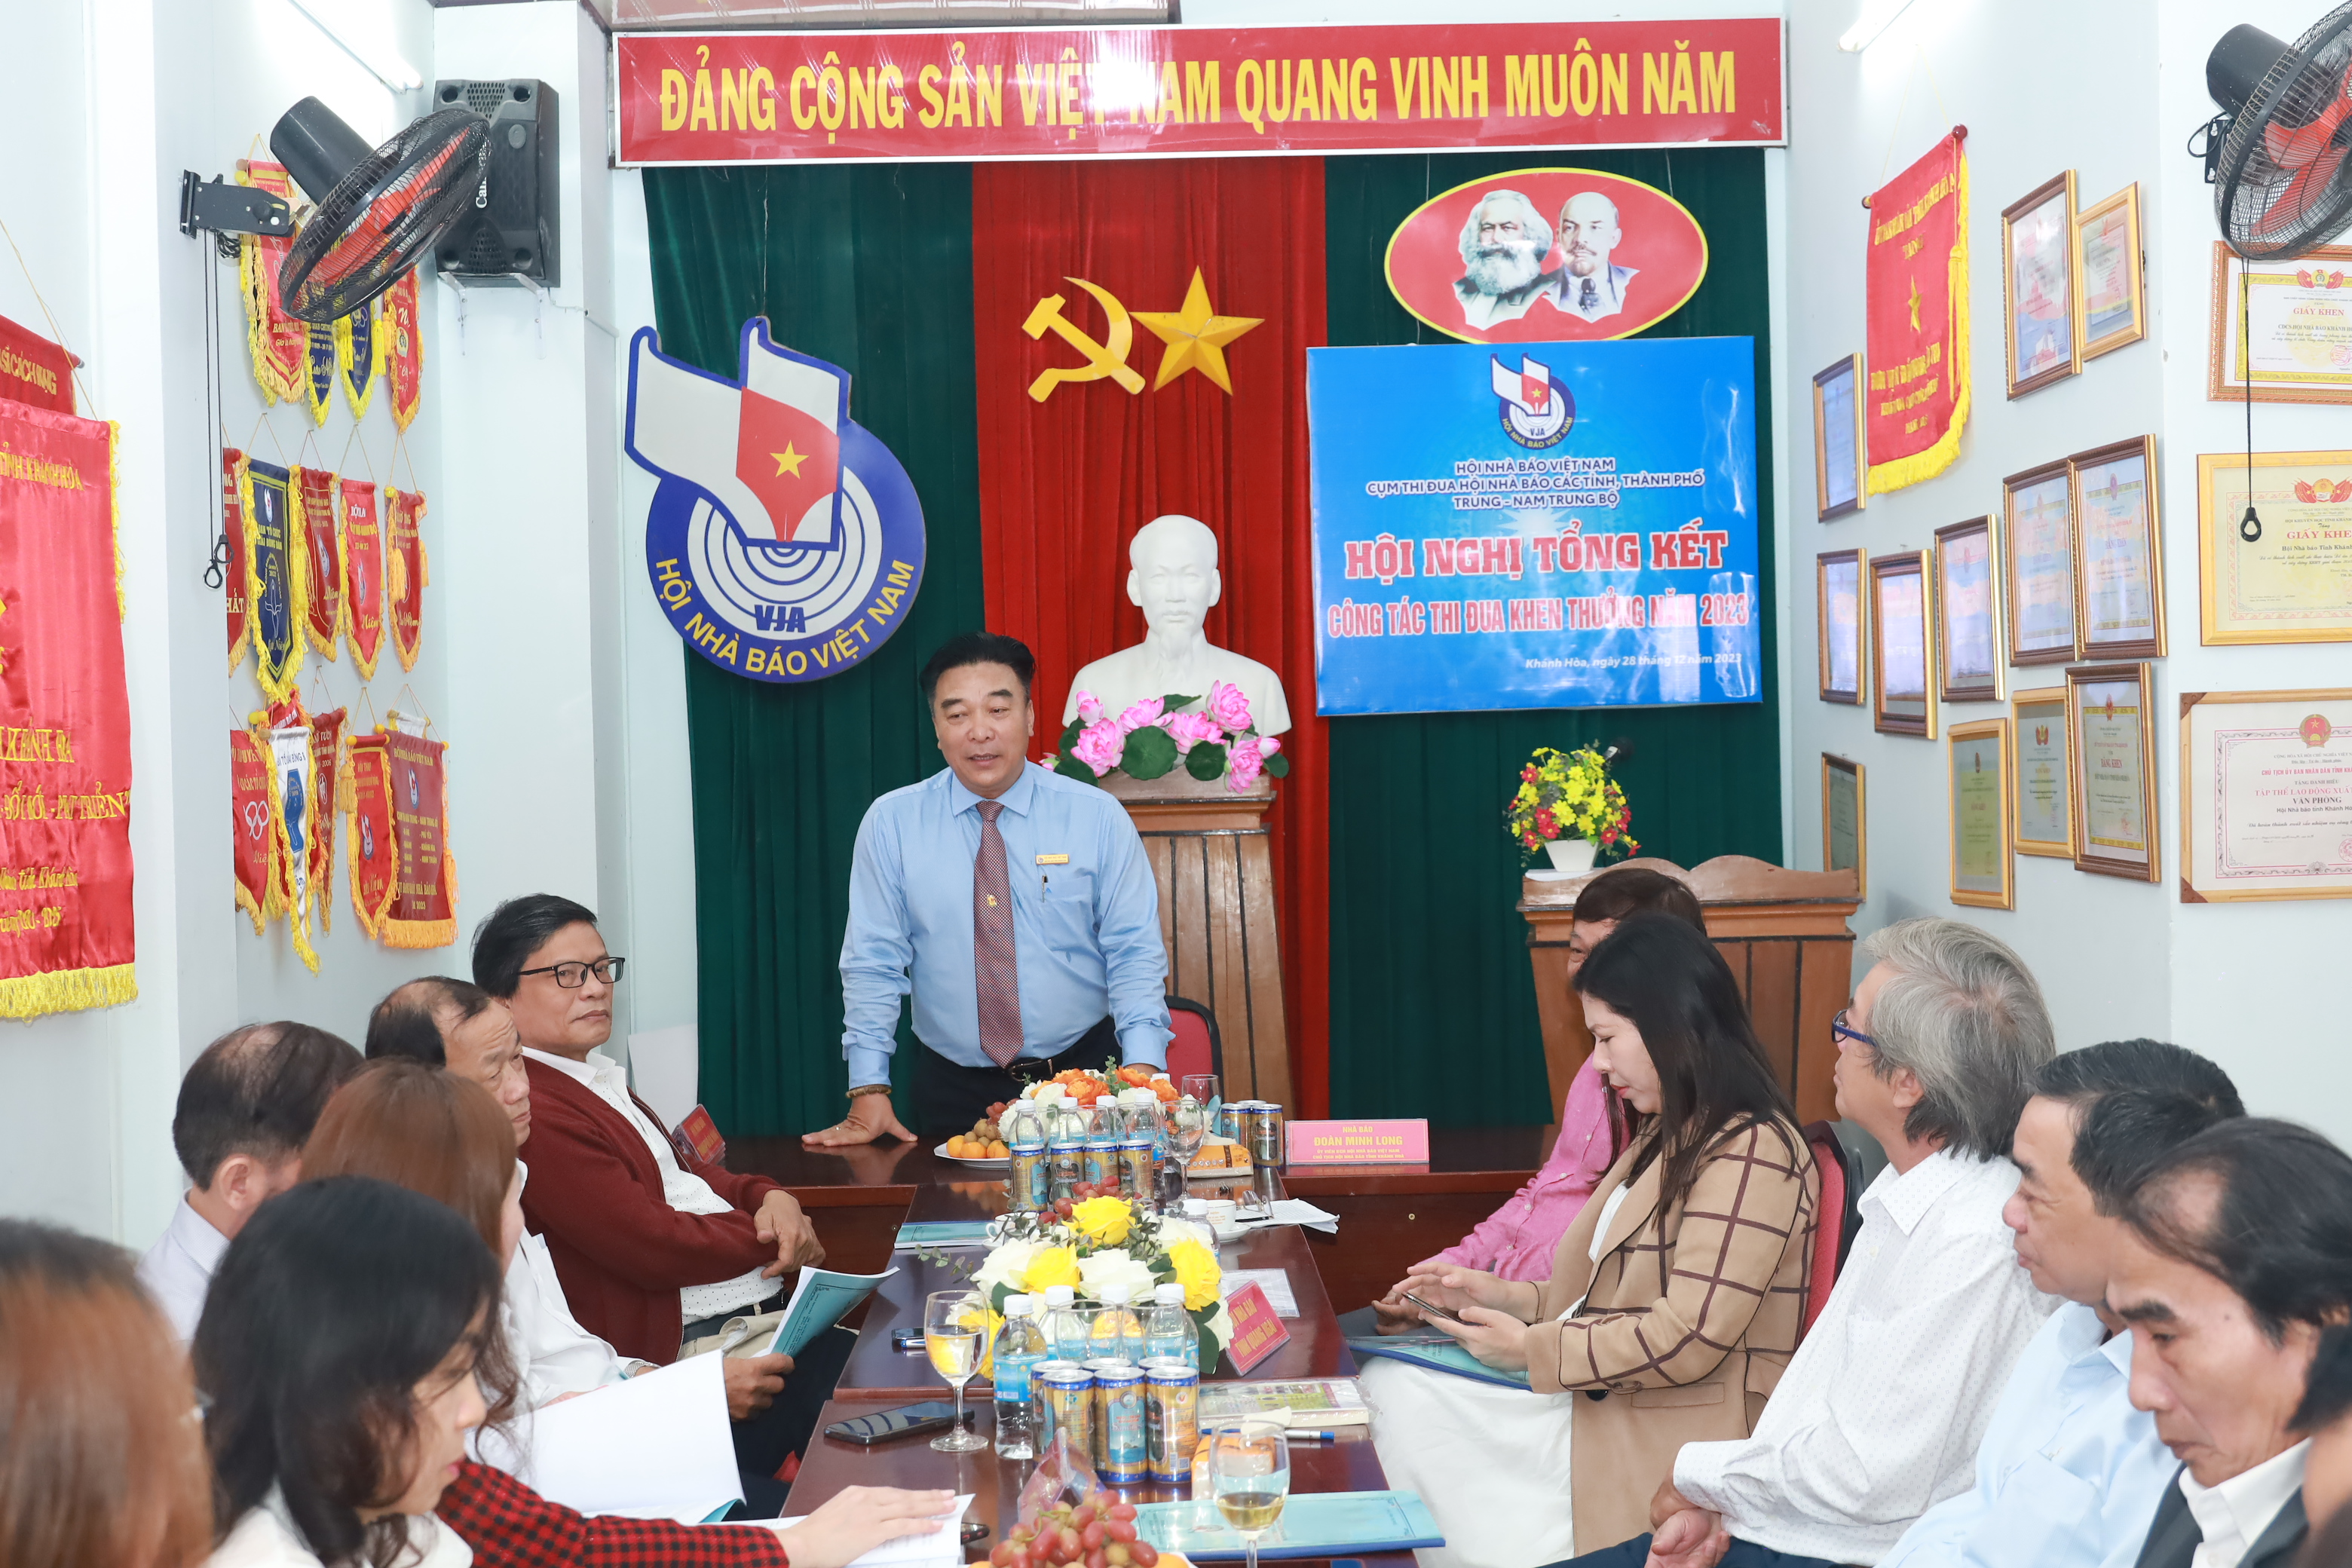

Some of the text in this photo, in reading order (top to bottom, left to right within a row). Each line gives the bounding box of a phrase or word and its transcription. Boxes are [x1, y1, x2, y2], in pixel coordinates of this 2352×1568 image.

[660, 44, 776, 131] ĐẢNG
[790, 51, 904, 144] CỘNG
[917, 41, 1002, 128] SẢN
[1236, 56, 1377, 134] QUANG
[1390, 55, 1488, 119] VINH
[1505, 38, 1628, 118] MUÔN
[1643, 39, 1736, 115] NĂM
[2293, 305, 2316, 315] GIẤY
[1502, 418, 1512, 432] HỘI
[1511, 431, 1526, 444] NHÀ
[1546, 433, 1563, 446] VIỆT
[1561, 417, 1573, 433] NAM
[1456, 457, 1614, 476] HỘI NHÀ BÁO VIỆT NAM
[1367, 469, 1704, 497] CỤM THI ĐUA HỘI NHÀ BÁO CÁC TỈNH, THÀNH PHỐ
[1454, 496, 1502, 508] TRUNG
[1513, 495, 1545, 507] NAM
[1548, 494, 1595, 506] TRUNG
[1599, 491, 1618, 507] BỘ
[2287, 528, 2352, 539] GIẤY KHE
[1346, 517, 1728, 585] HỘI NGHỊ TỔNG KẾT
[655, 558, 915, 676] HỘI NHÀ BÁO VIỆT NAM
[754, 604, 806, 633] VJA
[1328, 586, 1749, 638] CÔNG TÁC THI ĐUA KHEN THƯỞNG NĂM 2023
[1525, 657, 1562, 668] Khánh
[1564, 656, 1590, 668] Hòa,
[1593, 657, 1620, 669] ngày
[1622, 656, 1636, 665] 28
[1638, 655, 1671, 667] tháng
[1688, 655, 1712, 664] năm
[1714, 654, 1742, 663] 2023
[2255, 789, 2270, 797] TẬP
[2272, 786, 2288, 795] THỂ
[2308, 787, 2331, 795] ĐỘNG
[1343, 1125, 1374, 1133] NHÀ BÁO
[1314, 1135, 1403, 1146] ĐOÀN MINH LONG
